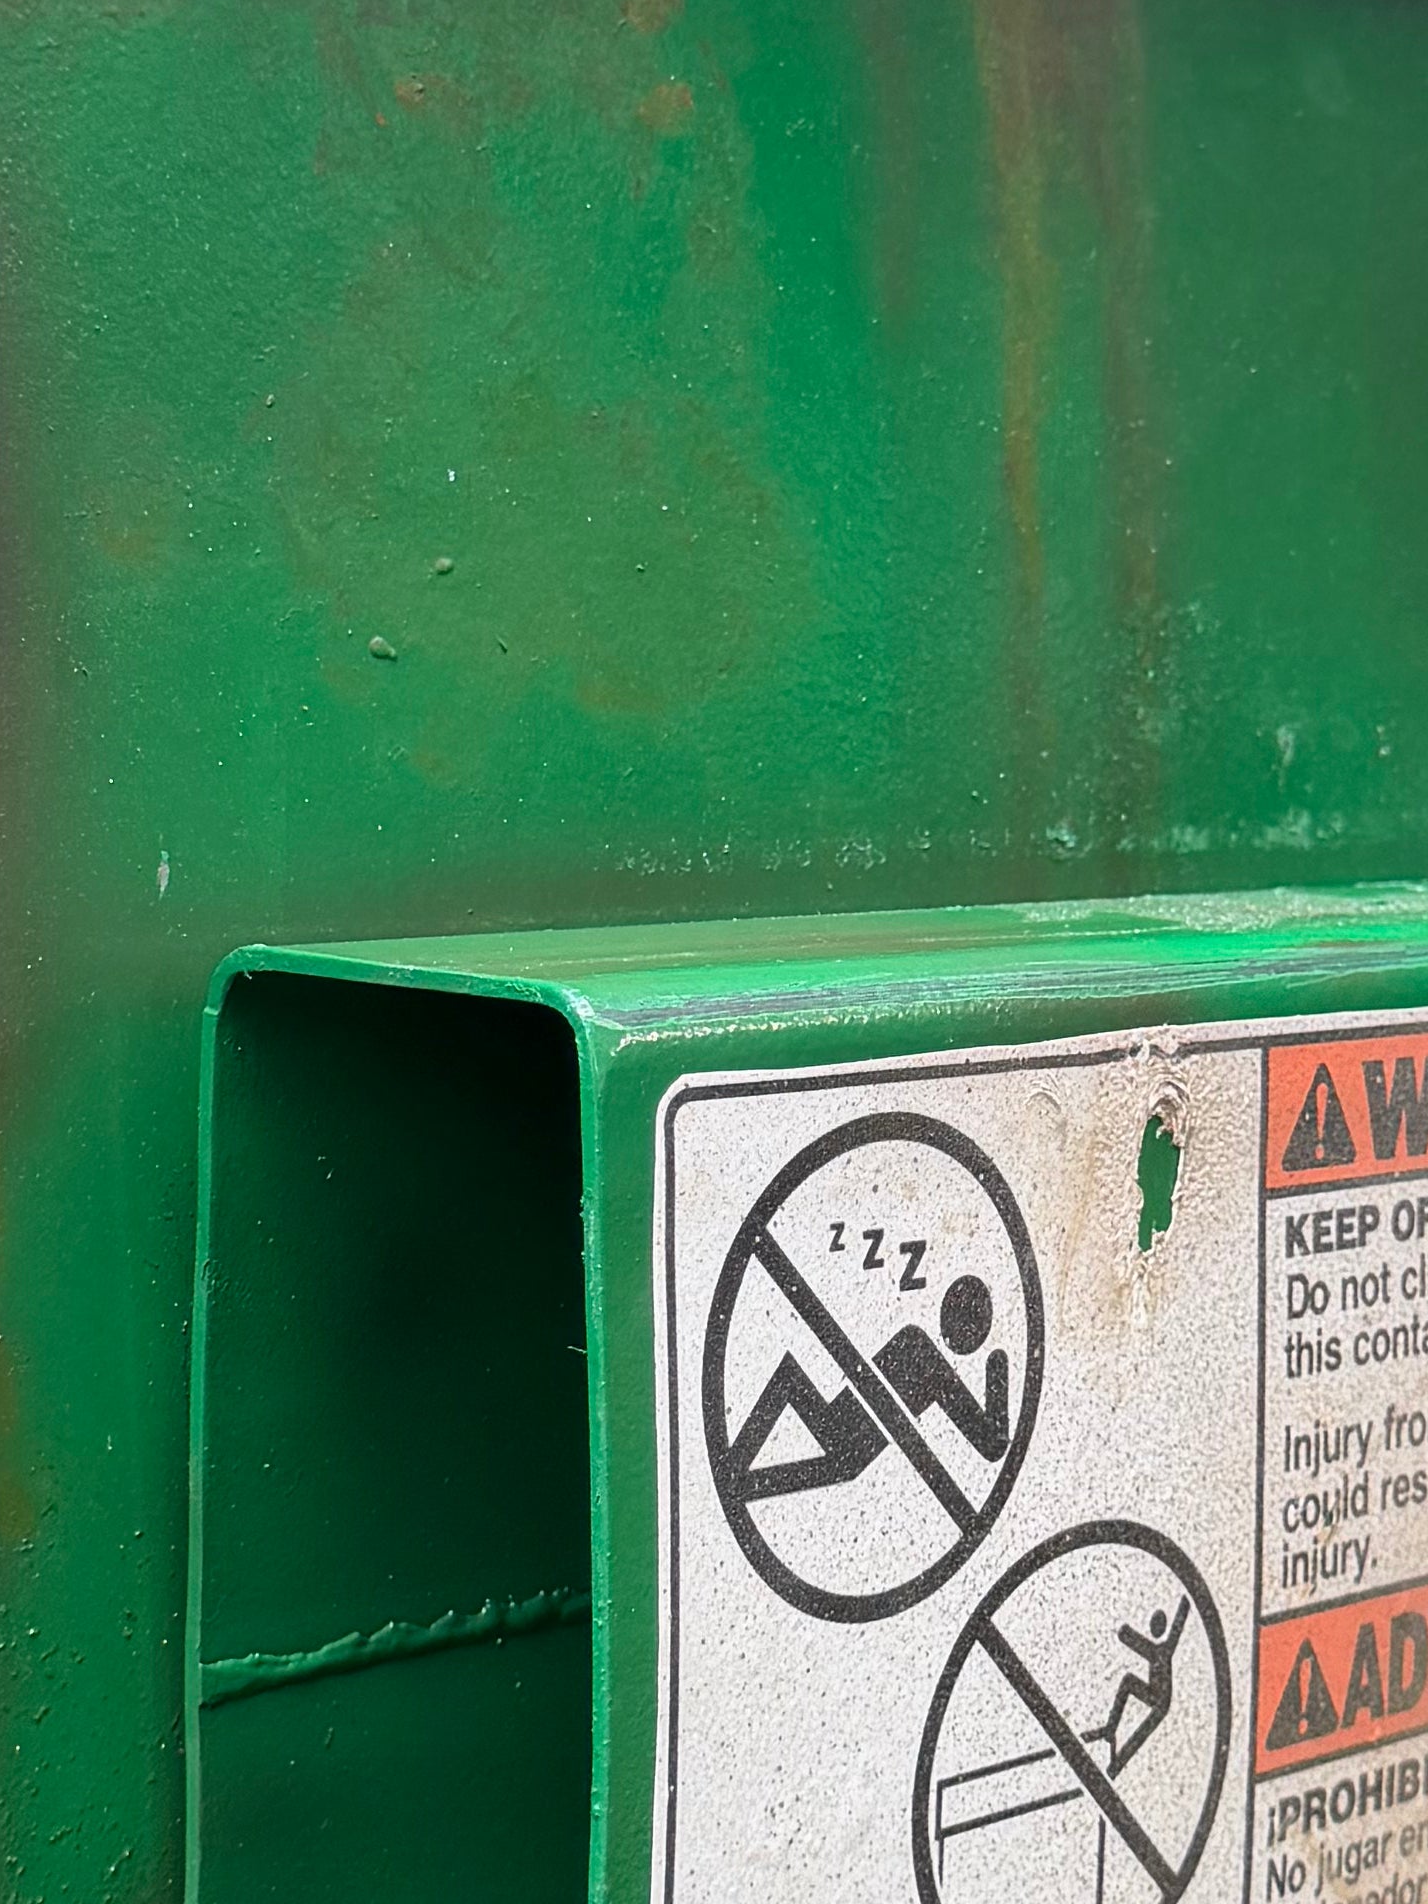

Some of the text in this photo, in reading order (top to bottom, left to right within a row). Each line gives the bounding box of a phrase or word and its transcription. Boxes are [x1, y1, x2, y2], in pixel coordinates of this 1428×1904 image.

[1285, 1205, 1379, 1257] KEEP
[1286, 1268, 1329, 1319] Do
[1341, 1264, 1391, 1308] not
[1285, 1333, 1341, 1378] this
[1284, 1421, 1372, 1473] Injury
[1282, 1476, 1369, 1534] could
[1281, 1533, 1379, 1595] injury.
[1267, 1856, 1307, 1902] No
[1316, 1832, 1390, 1891] jugar
